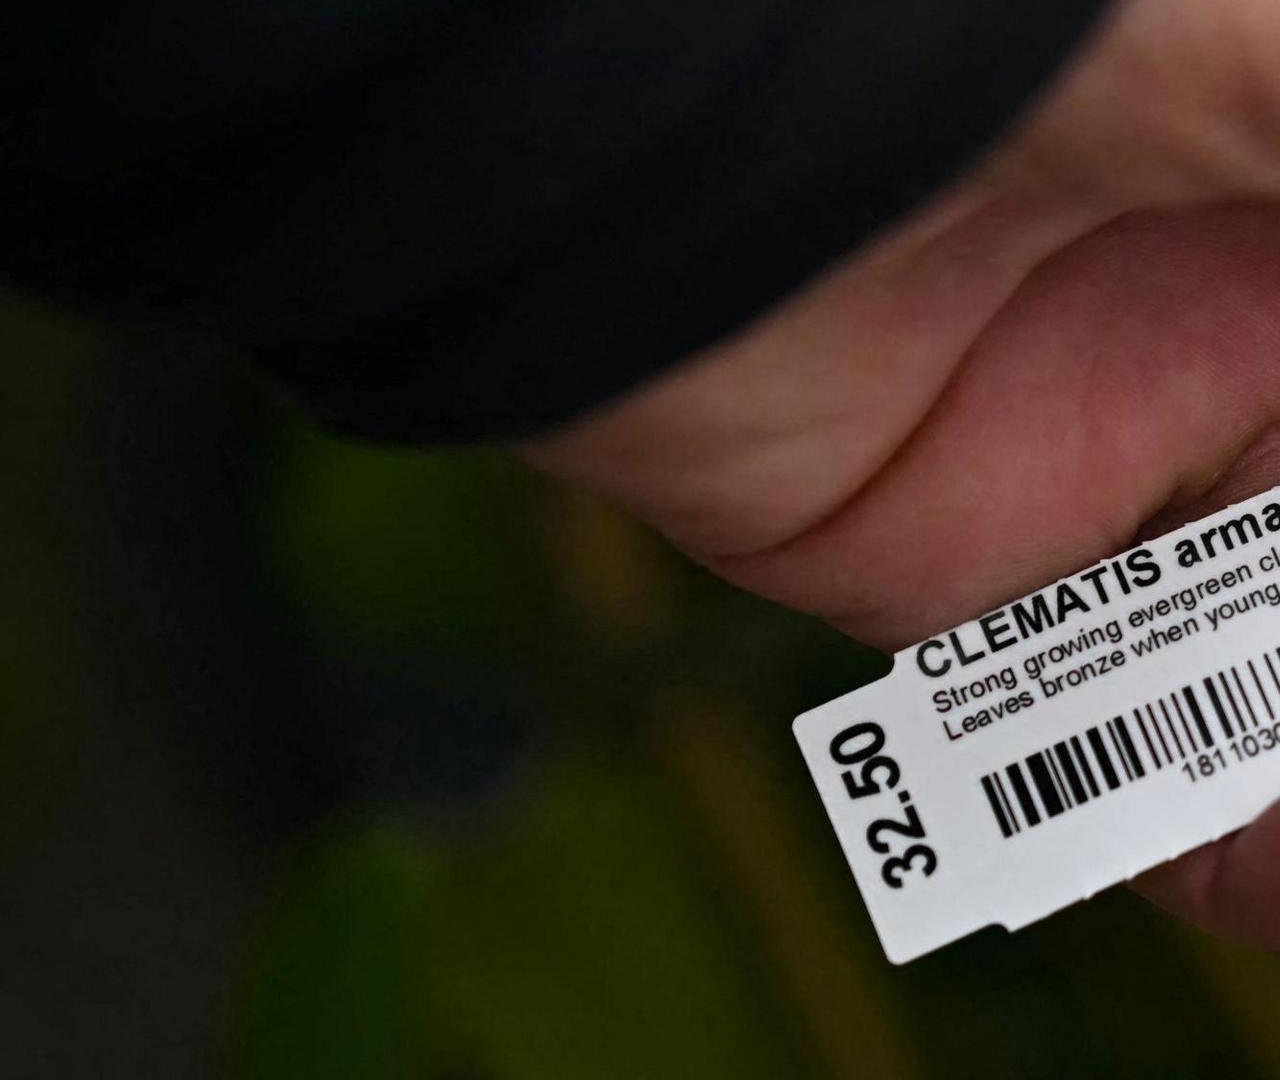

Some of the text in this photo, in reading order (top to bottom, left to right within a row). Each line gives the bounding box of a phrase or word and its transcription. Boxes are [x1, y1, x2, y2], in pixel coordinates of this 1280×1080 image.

[915, 548, 1162, 678] CLEMATIS
[932, 668, 1018, 713] Strong
[1024, 621, 1123, 678] growing
[1128, 564, 1253, 628] evergreen
[942, 689, 1035, 742] Leaves
[1040, 649, 1126, 698] bronze
[1131, 618, 1200, 658] when
[829, 721, 938, 890] 32.50
